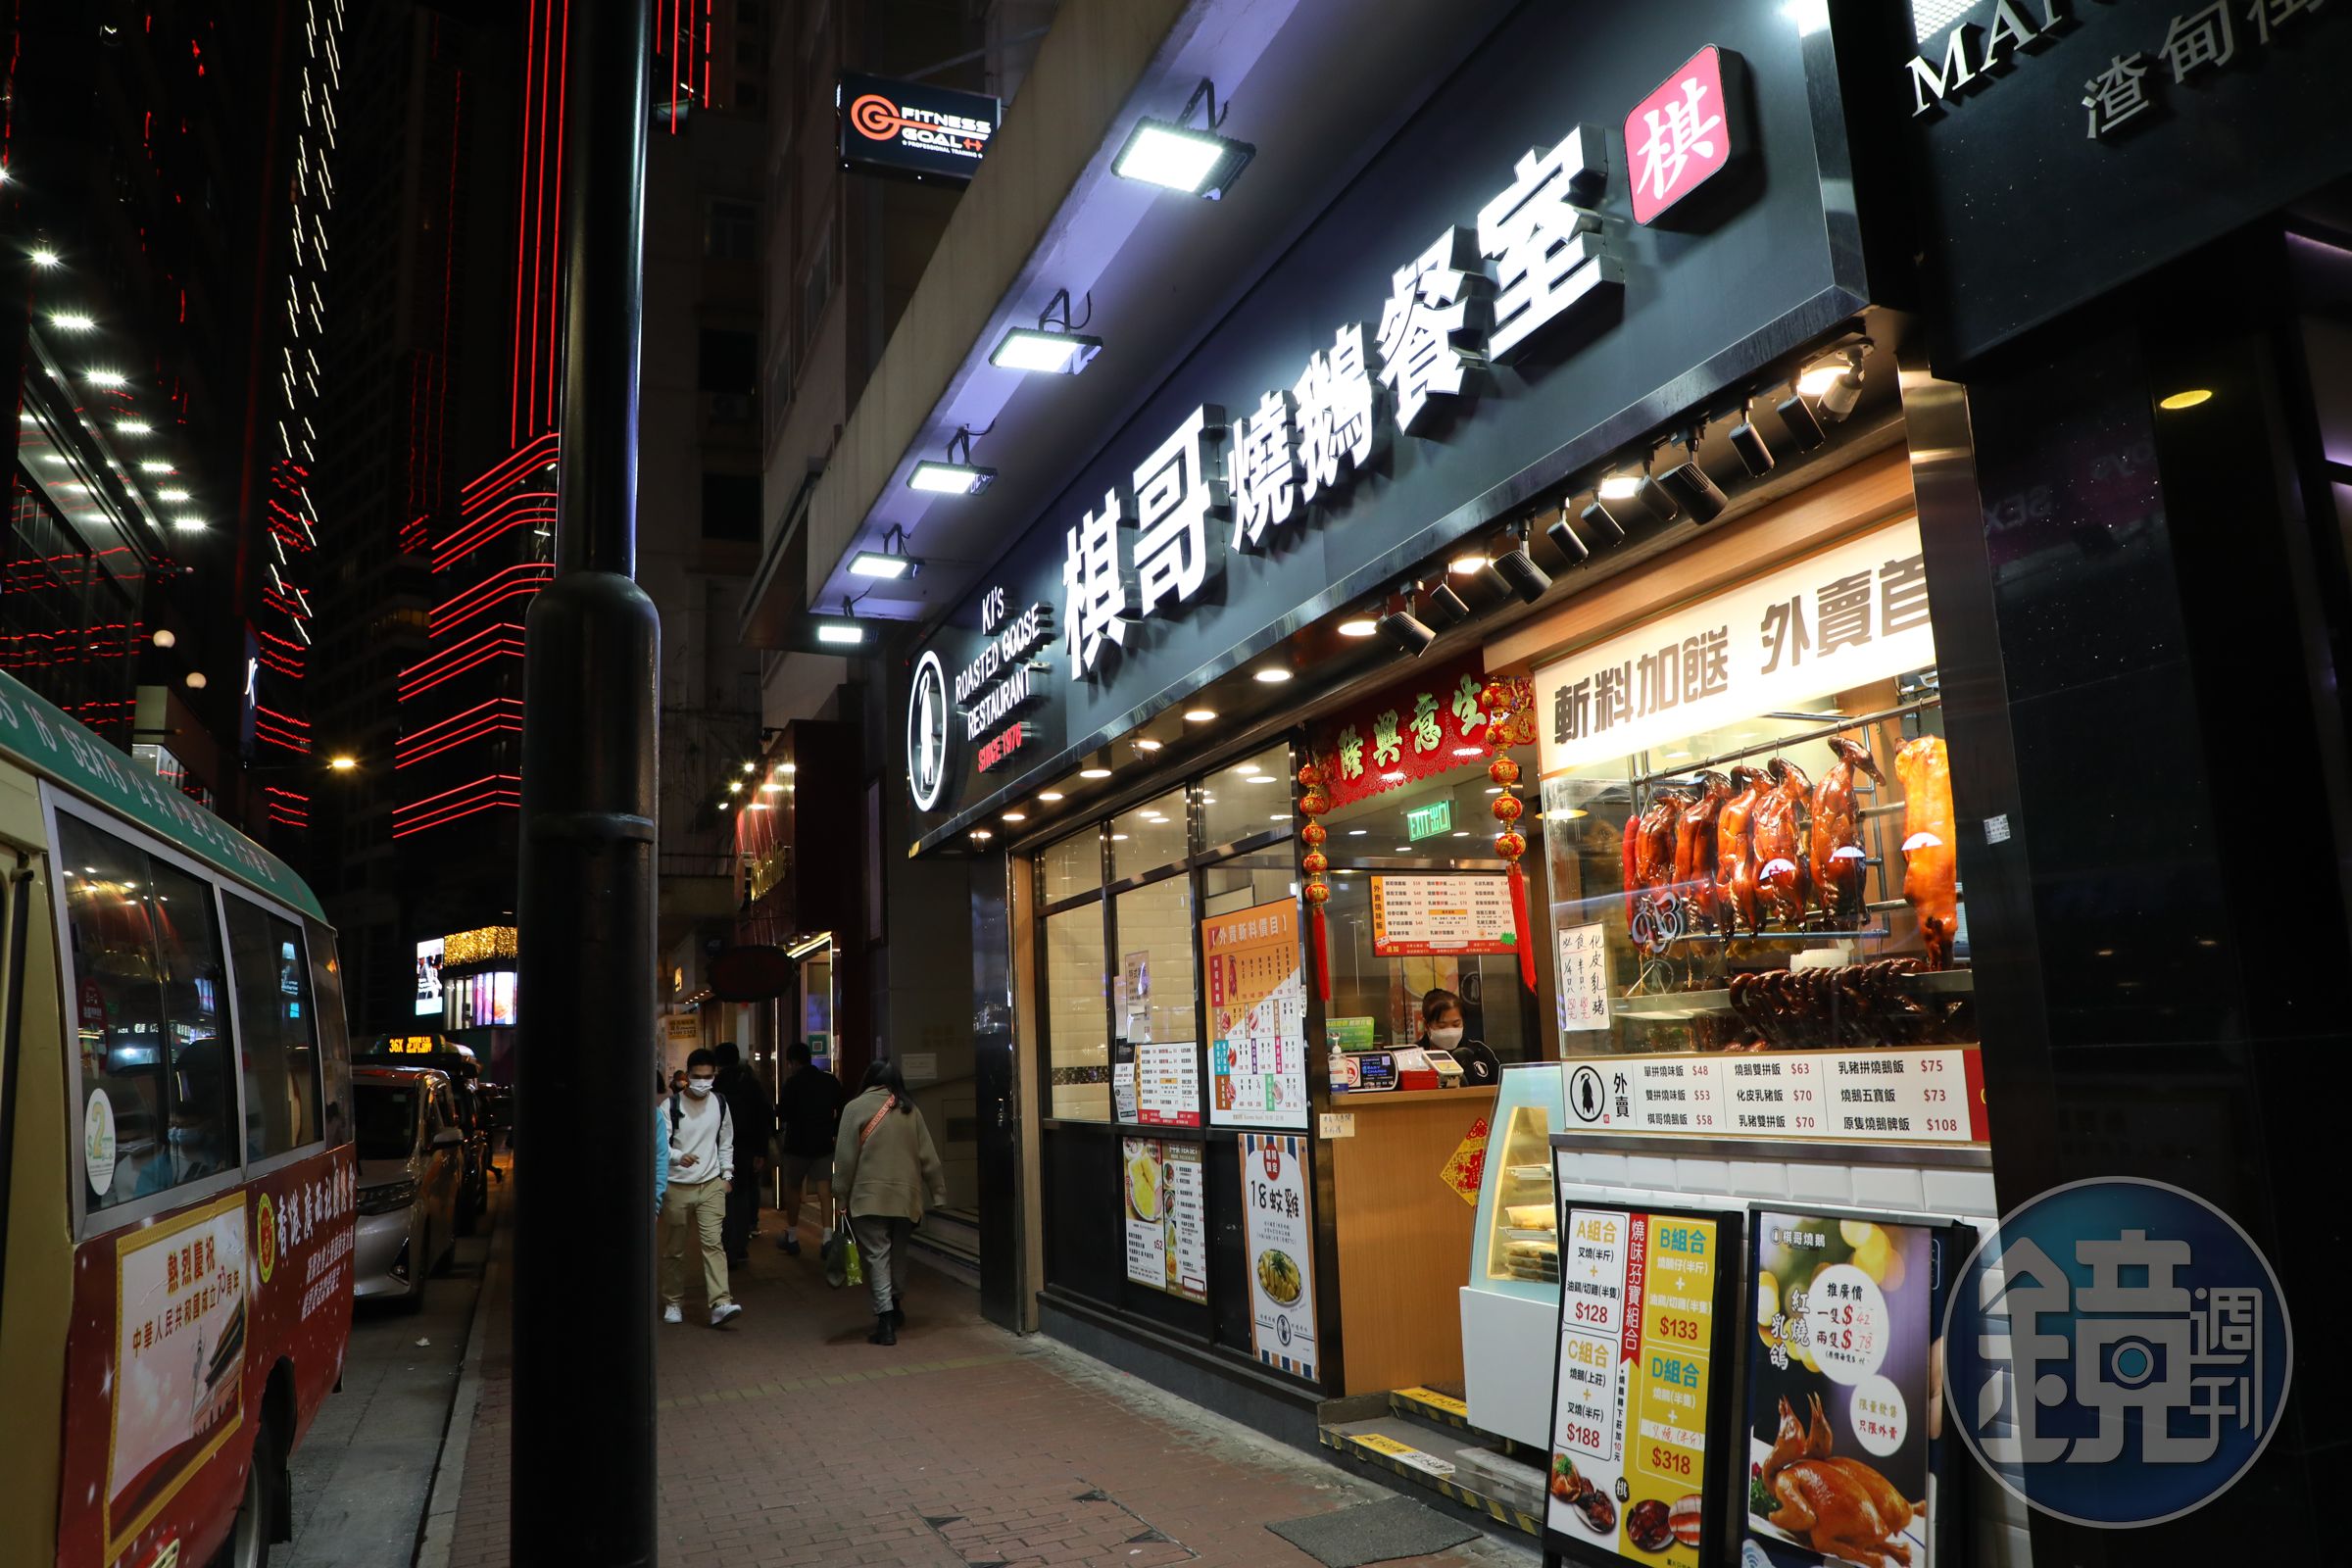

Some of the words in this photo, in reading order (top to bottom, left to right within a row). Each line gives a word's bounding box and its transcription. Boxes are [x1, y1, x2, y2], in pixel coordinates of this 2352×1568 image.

[901, 106, 992, 134] FITNESS
[901, 126, 963, 149] GOAL
[1636, 77, 1722, 201] 棋
[1061, 122, 1603, 681] 棋哥燒鵝餐室
[955, 641, 1000, 704] ROASTED
[1002, 602, 1041, 662] GOOSE
[967, 662, 1030, 742] RESTAURANT
[22, 700, 58, 753] 16
[59, 723, 128, 795] SEATS
[977, 737, 1002, 774] SINCE
[1409, 816, 1431, 839] EXIT
[1430, 803, 1450, 833] 出口
[389, 1038, 404, 1054] 36X
[1692, 1065, 1709, 1076] $48
[1790, 1063, 1810, 1074] $63
[1920, 1059, 1943, 1072] $75
[1614, 1072, 1630, 1118] 外賣
[1694, 1090, 1710, 1101] $53
[1737, 1090, 1784, 1102] 化皮乳豬飯
[1793, 1090, 1812, 1102] $70
[1924, 1089, 1946, 1102] $73
[1696, 1113, 1713, 1125] $58
[1795, 1116, 1815, 1128] $70
[1927, 1118, 1957, 1131] $108
[1250, 1180, 1299, 1219] 18蚊雞
[1577, 1220, 1617, 1245] A組合
[1660, 1228, 1707, 1255] B組合
[1783, 1230, 1826, 1248] 棋哥燒鵝
[1578, 1247, 1614, 1263] 叉燒(半斤)
[1625, 1219, 1645, 1350] 燒味孖寶組合
[1827, 1282, 1863, 1302] 推廣價
[1575, 1301, 1608, 1324] $128
[1660, 1317, 1698, 1342] $133
[1568, 1340, 1609, 1368] C組合
[1651, 1357, 1700, 1389] D組合
[1567, 1401, 1604, 1423] 叉燒(半斤)
[1566, 1422, 1600, 1448] $188
[1652, 1446, 1690, 1474] $318
